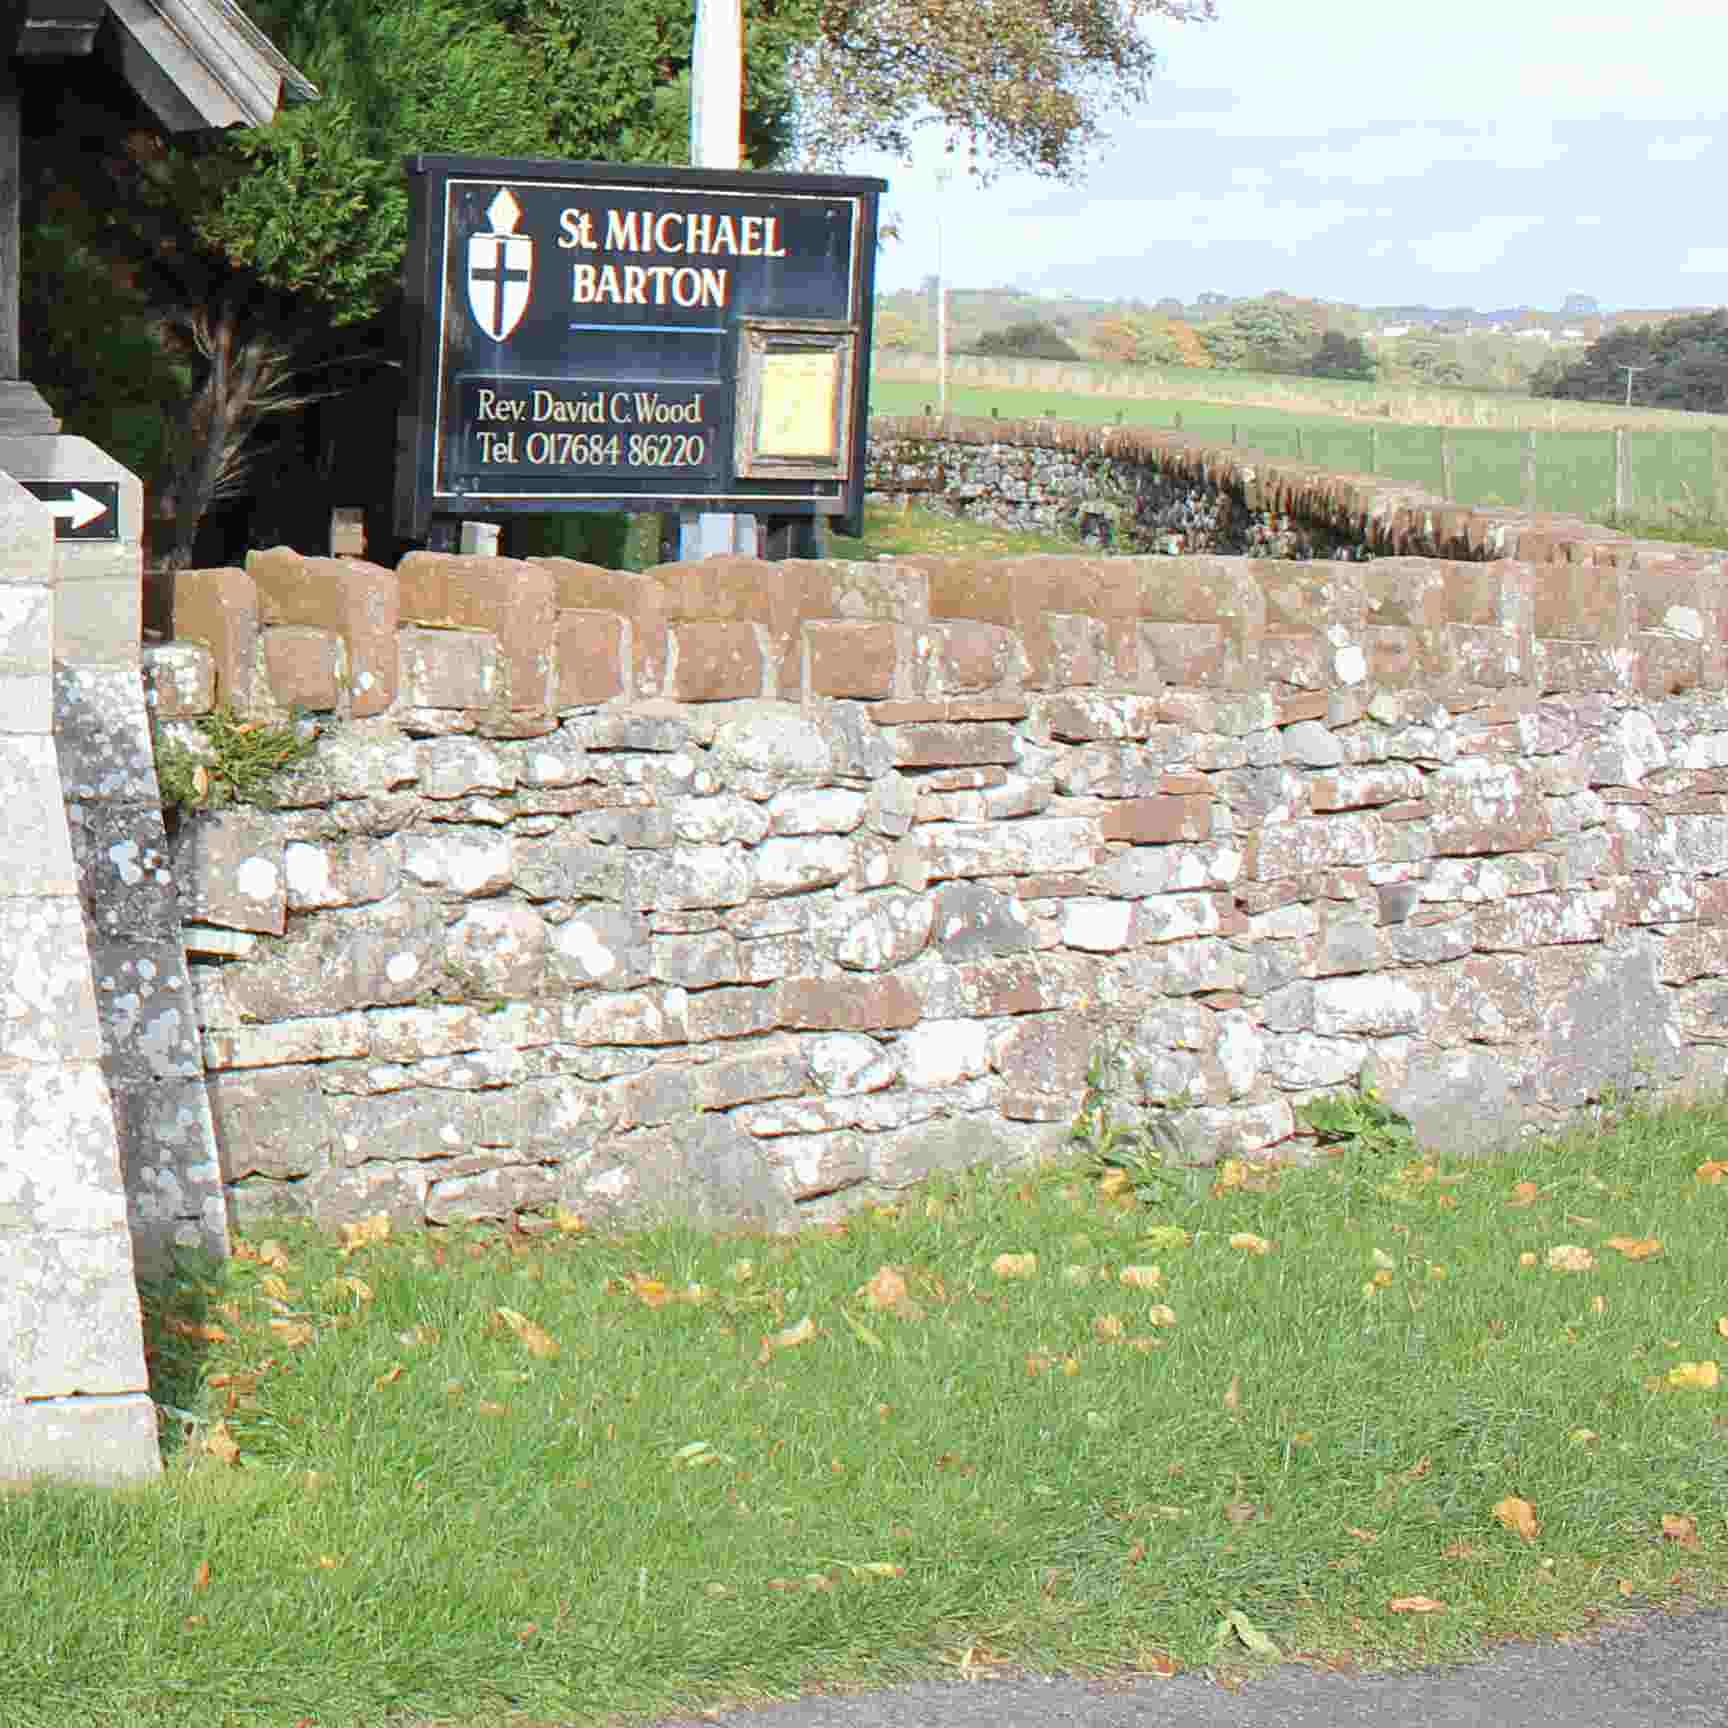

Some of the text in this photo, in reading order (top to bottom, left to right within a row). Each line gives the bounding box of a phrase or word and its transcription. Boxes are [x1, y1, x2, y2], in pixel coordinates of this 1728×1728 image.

[605, 210, 785, 256] MICHAEL
[572, 264, 727, 307] BARTON
[476, 389, 526, 422] Rev.
[532, 391, 606, 422] David
[634, 393, 703, 423] Wood
[527, 432, 621, 464] 017684
[627, 434, 705, 466] 86220
